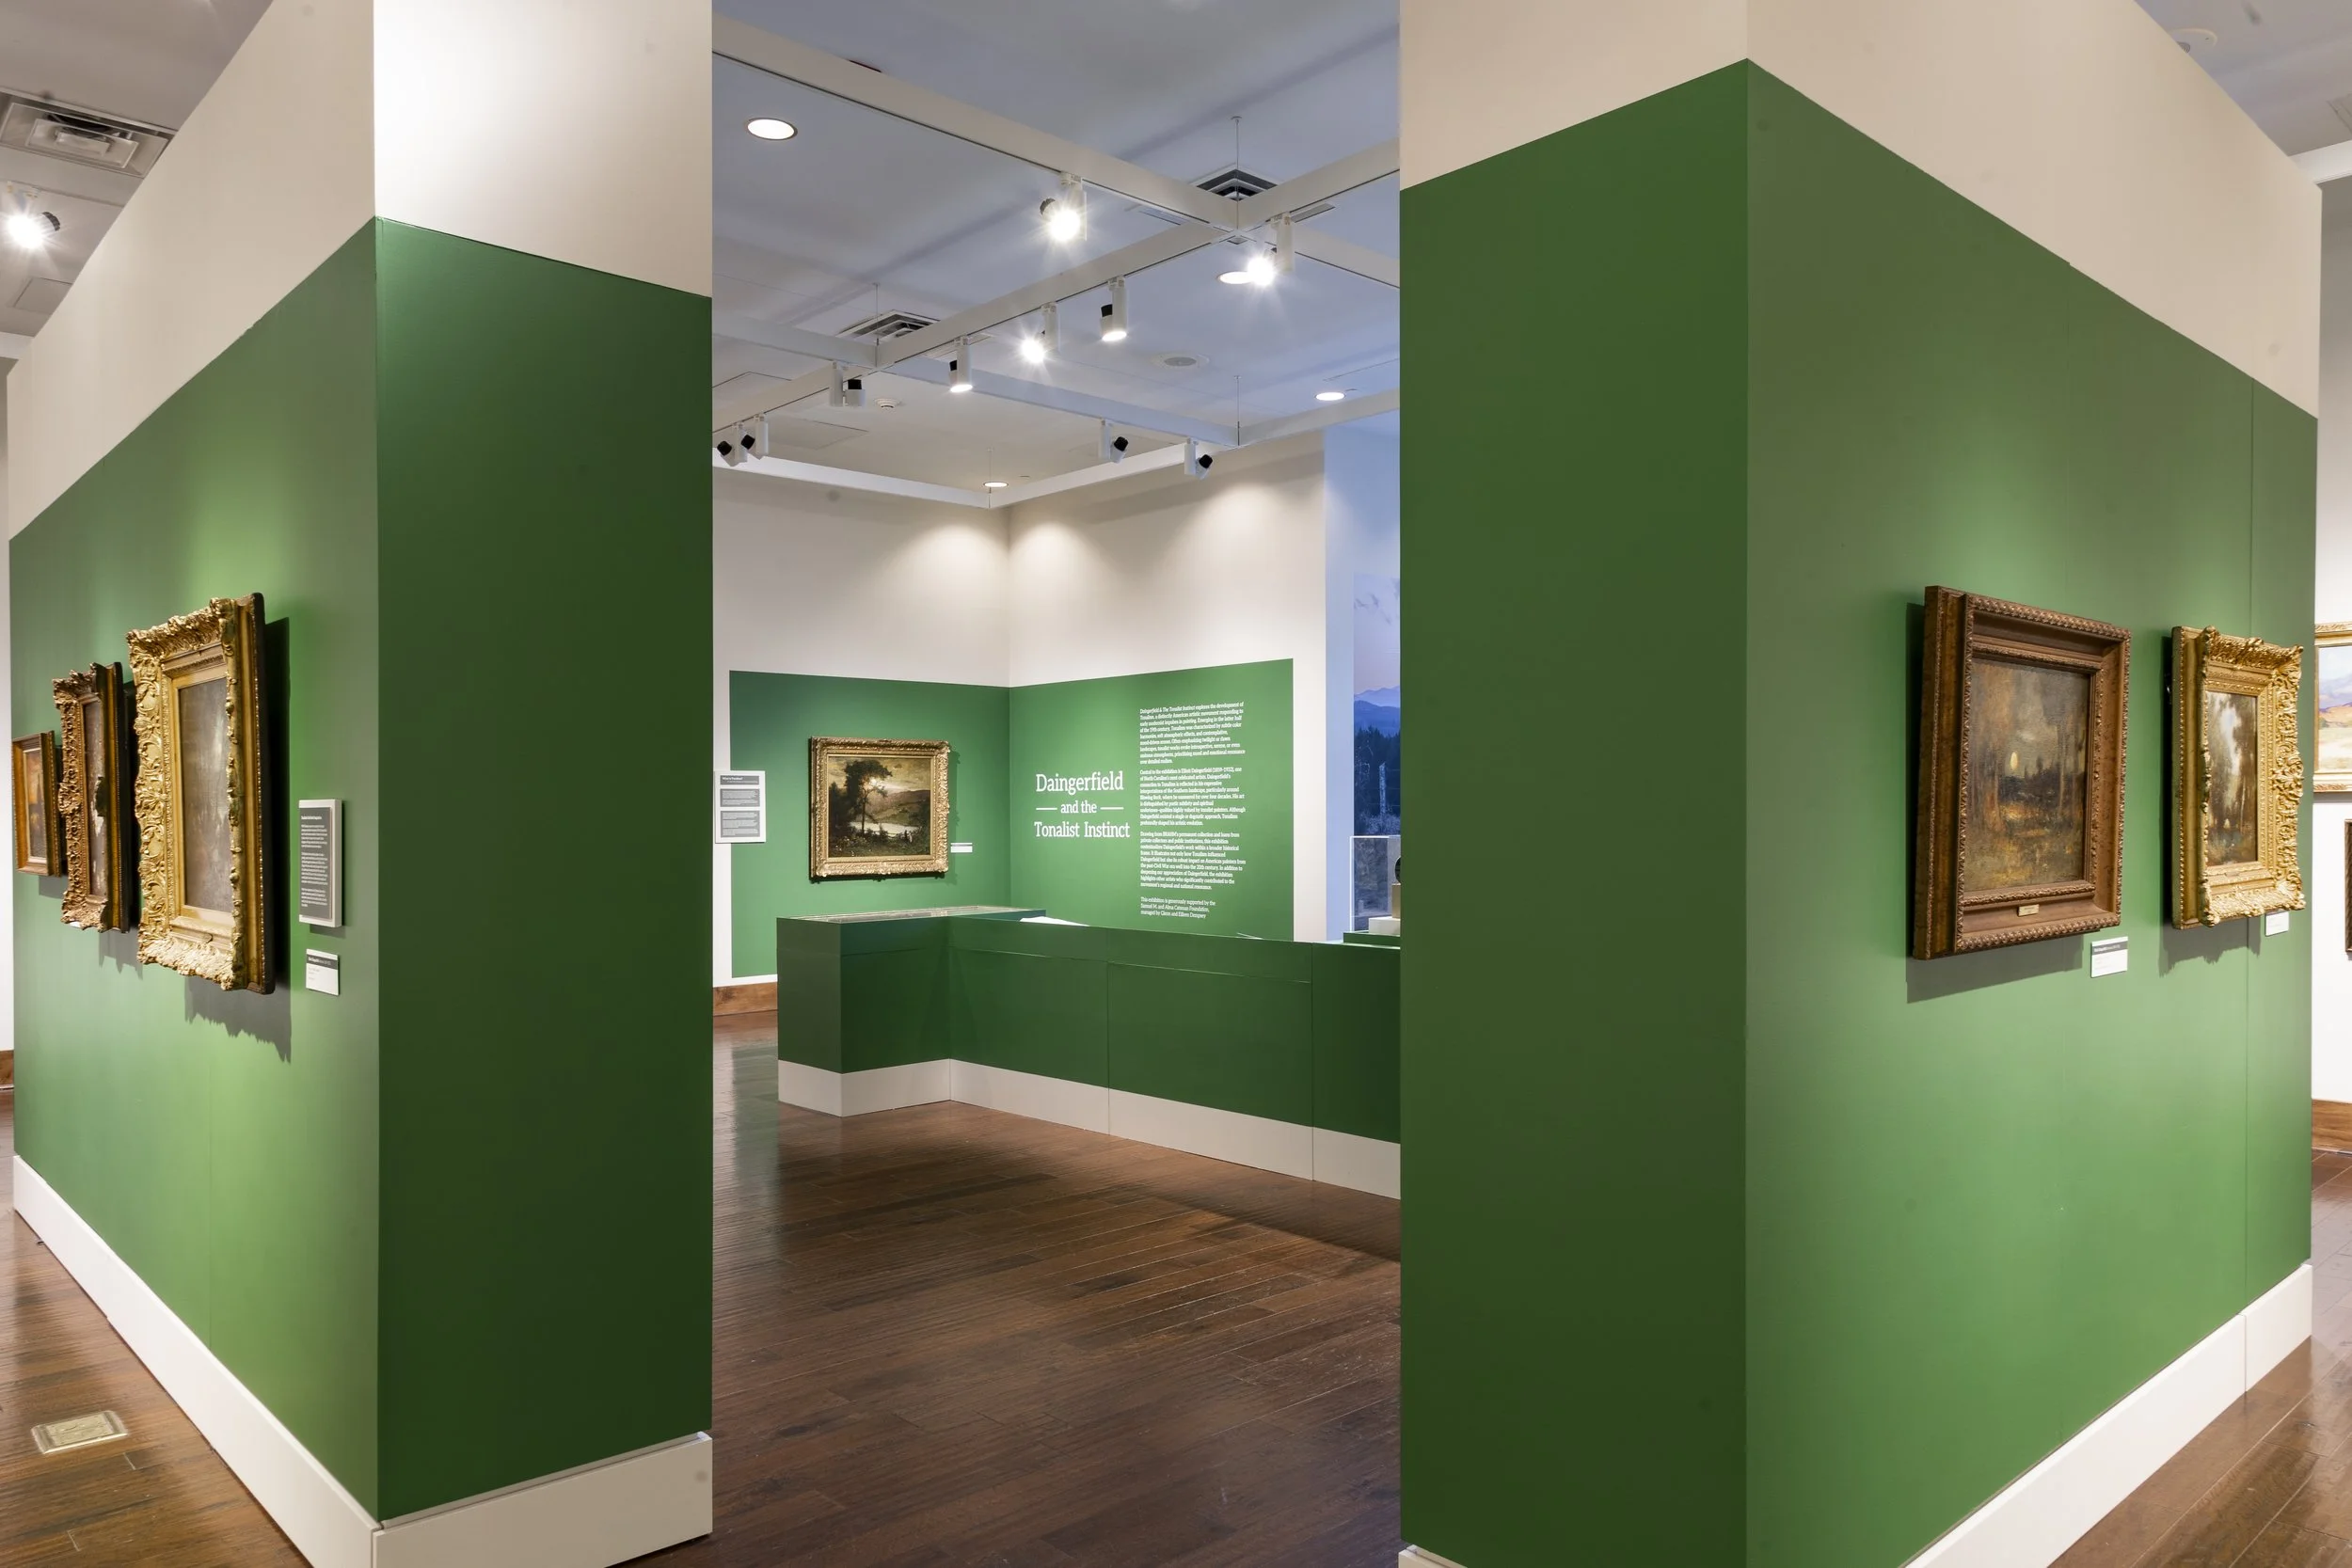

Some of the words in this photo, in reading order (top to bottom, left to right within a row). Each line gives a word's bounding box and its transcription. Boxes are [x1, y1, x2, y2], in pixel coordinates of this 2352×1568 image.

[1036, 770, 1124, 796] Daingerfield
[1060, 800, 1079, 814] and
[1081, 800, 1097, 814] the
[1034, 820, 1080, 837] Tonalist
[1084, 821, 1131, 838] Instinct
